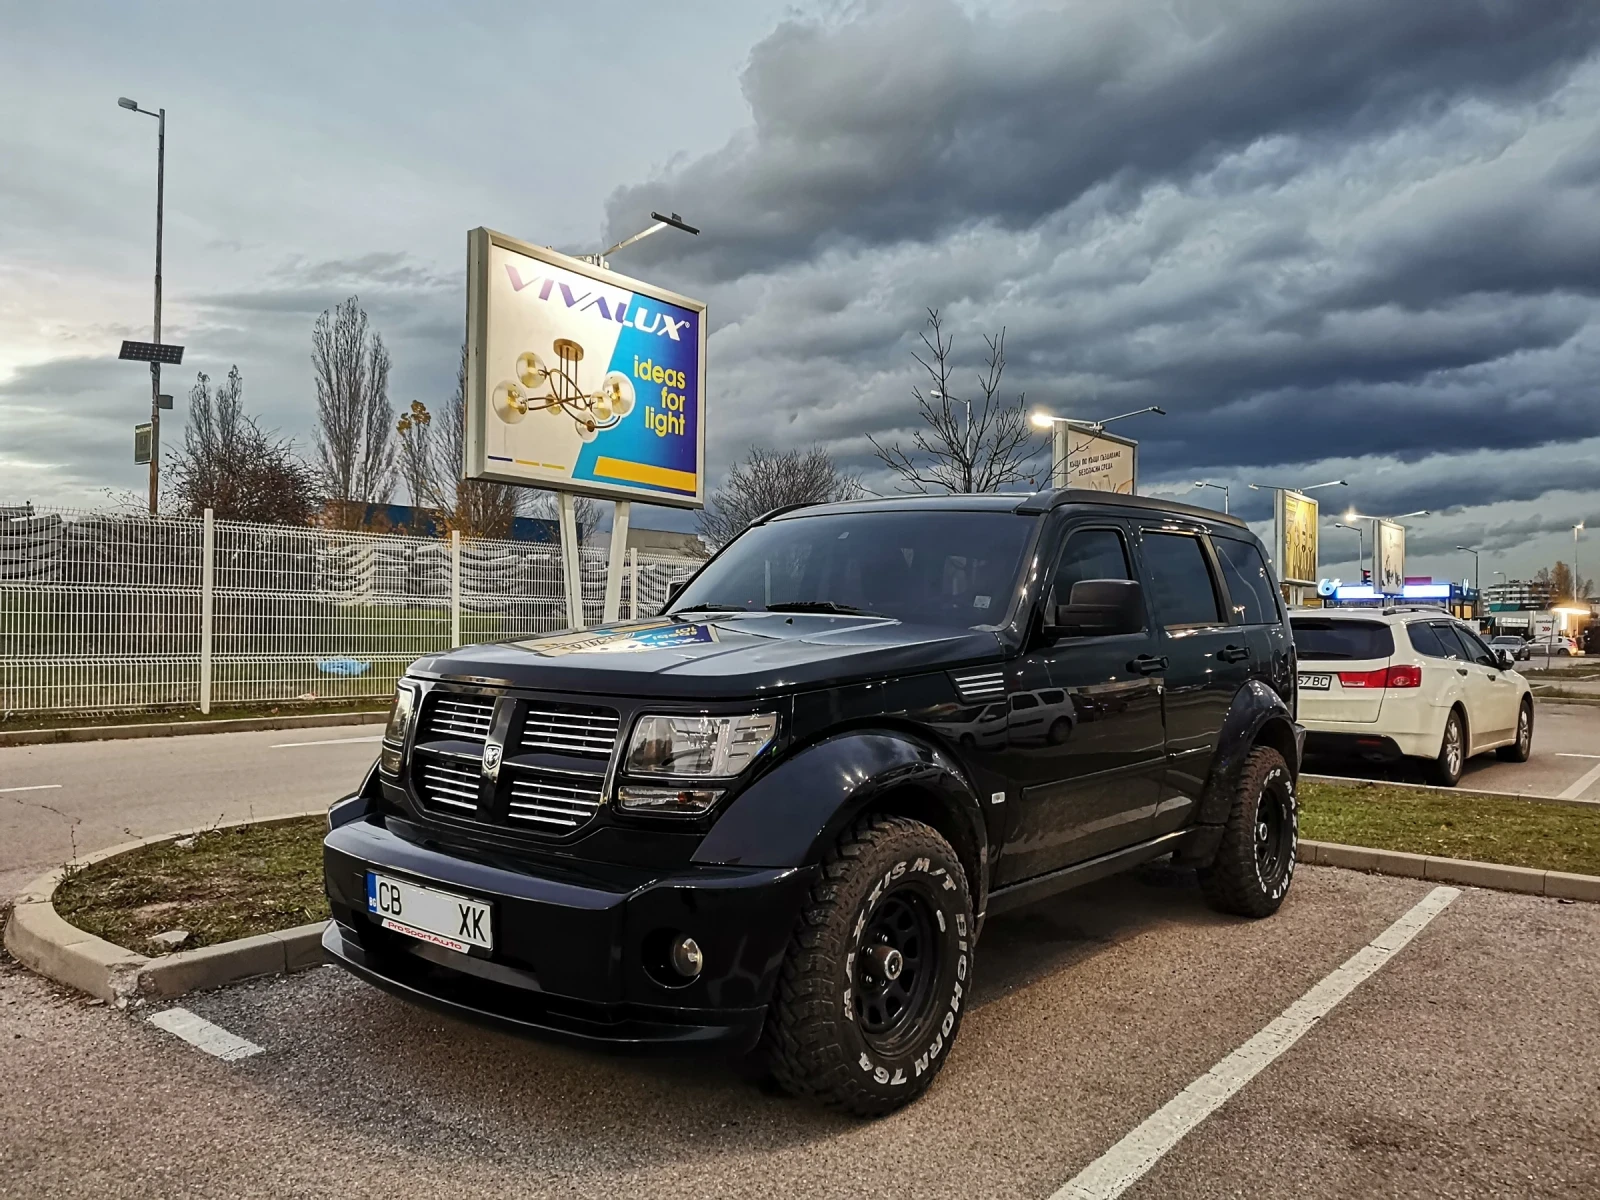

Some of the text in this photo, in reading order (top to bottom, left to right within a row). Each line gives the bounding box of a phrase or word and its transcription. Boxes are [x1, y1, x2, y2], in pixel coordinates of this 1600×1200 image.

[633, 355, 686, 390] ideas
[661, 387, 685, 411] for
[645, 406, 686, 437] light
[1312, 676, 1329, 687] BC
[379, 882, 487, 942] CB XK
[843, 861, 907, 1022] MAXXIS
[914, 913, 968, 1077] BIGHORN
